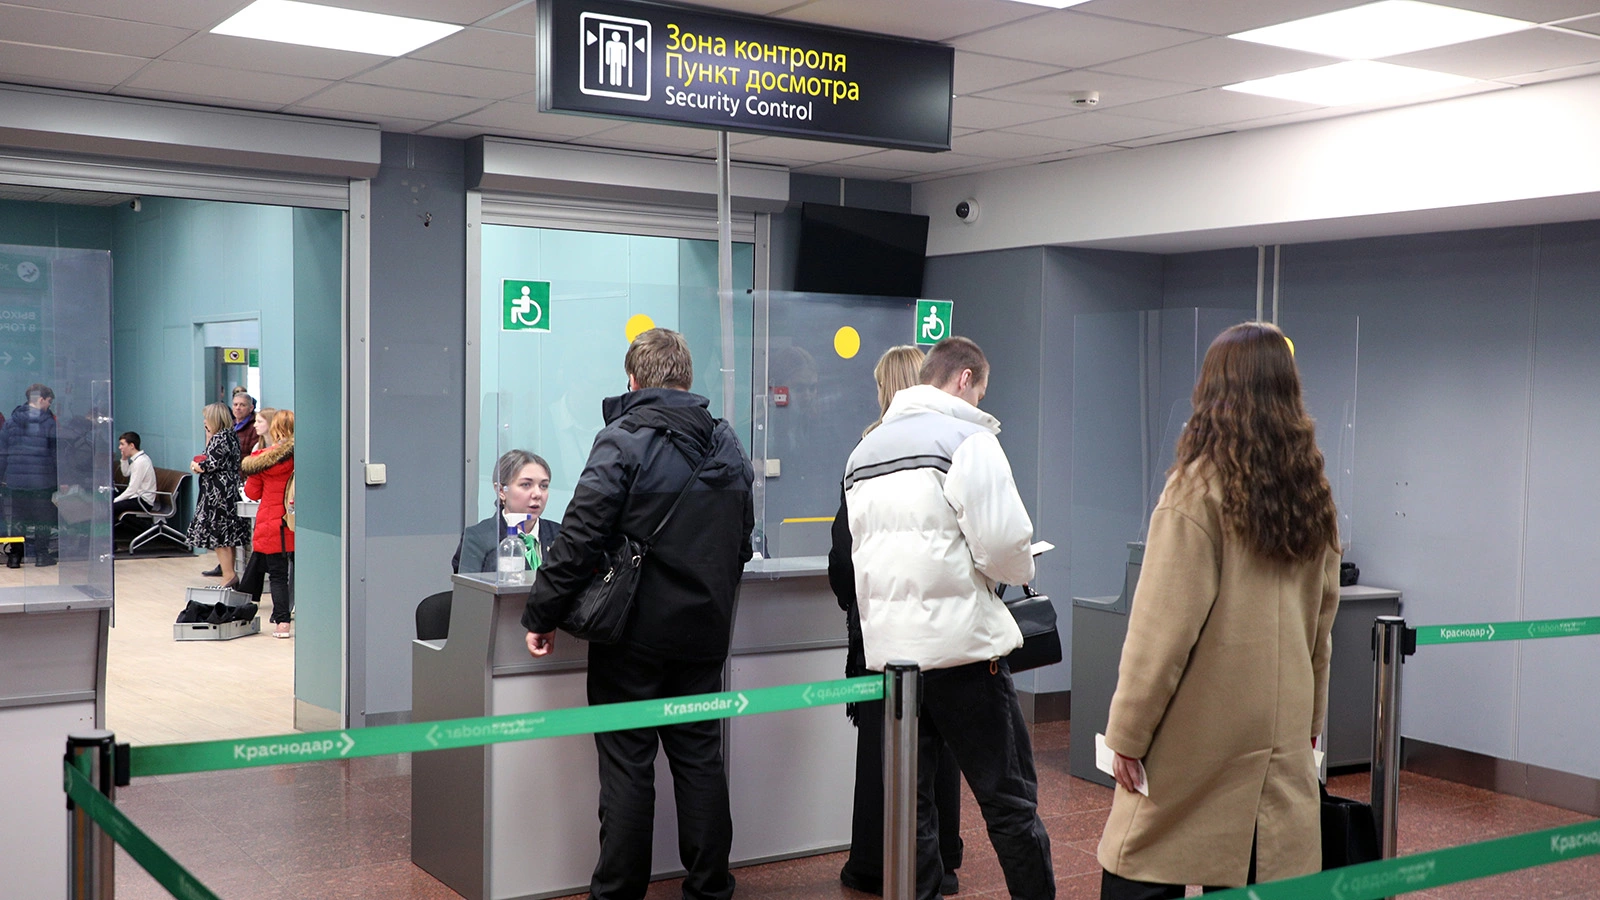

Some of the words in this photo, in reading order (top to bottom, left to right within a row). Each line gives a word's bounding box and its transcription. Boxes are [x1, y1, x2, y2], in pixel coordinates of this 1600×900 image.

[666, 23, 726, 57] Зона
[734, 40, 847, 73] контроля
[665, 51, 741, 87] Пункт
[745, 69, 860, 105] досмотра
[665, 86, 741, 117] Security
[745, 96, 813, 121] Control
[1440, 627, 1485, 639] Краснодар
[663, 696, 733, 717] Krasnodar
[233, 738, 334, 762] Краснодар
